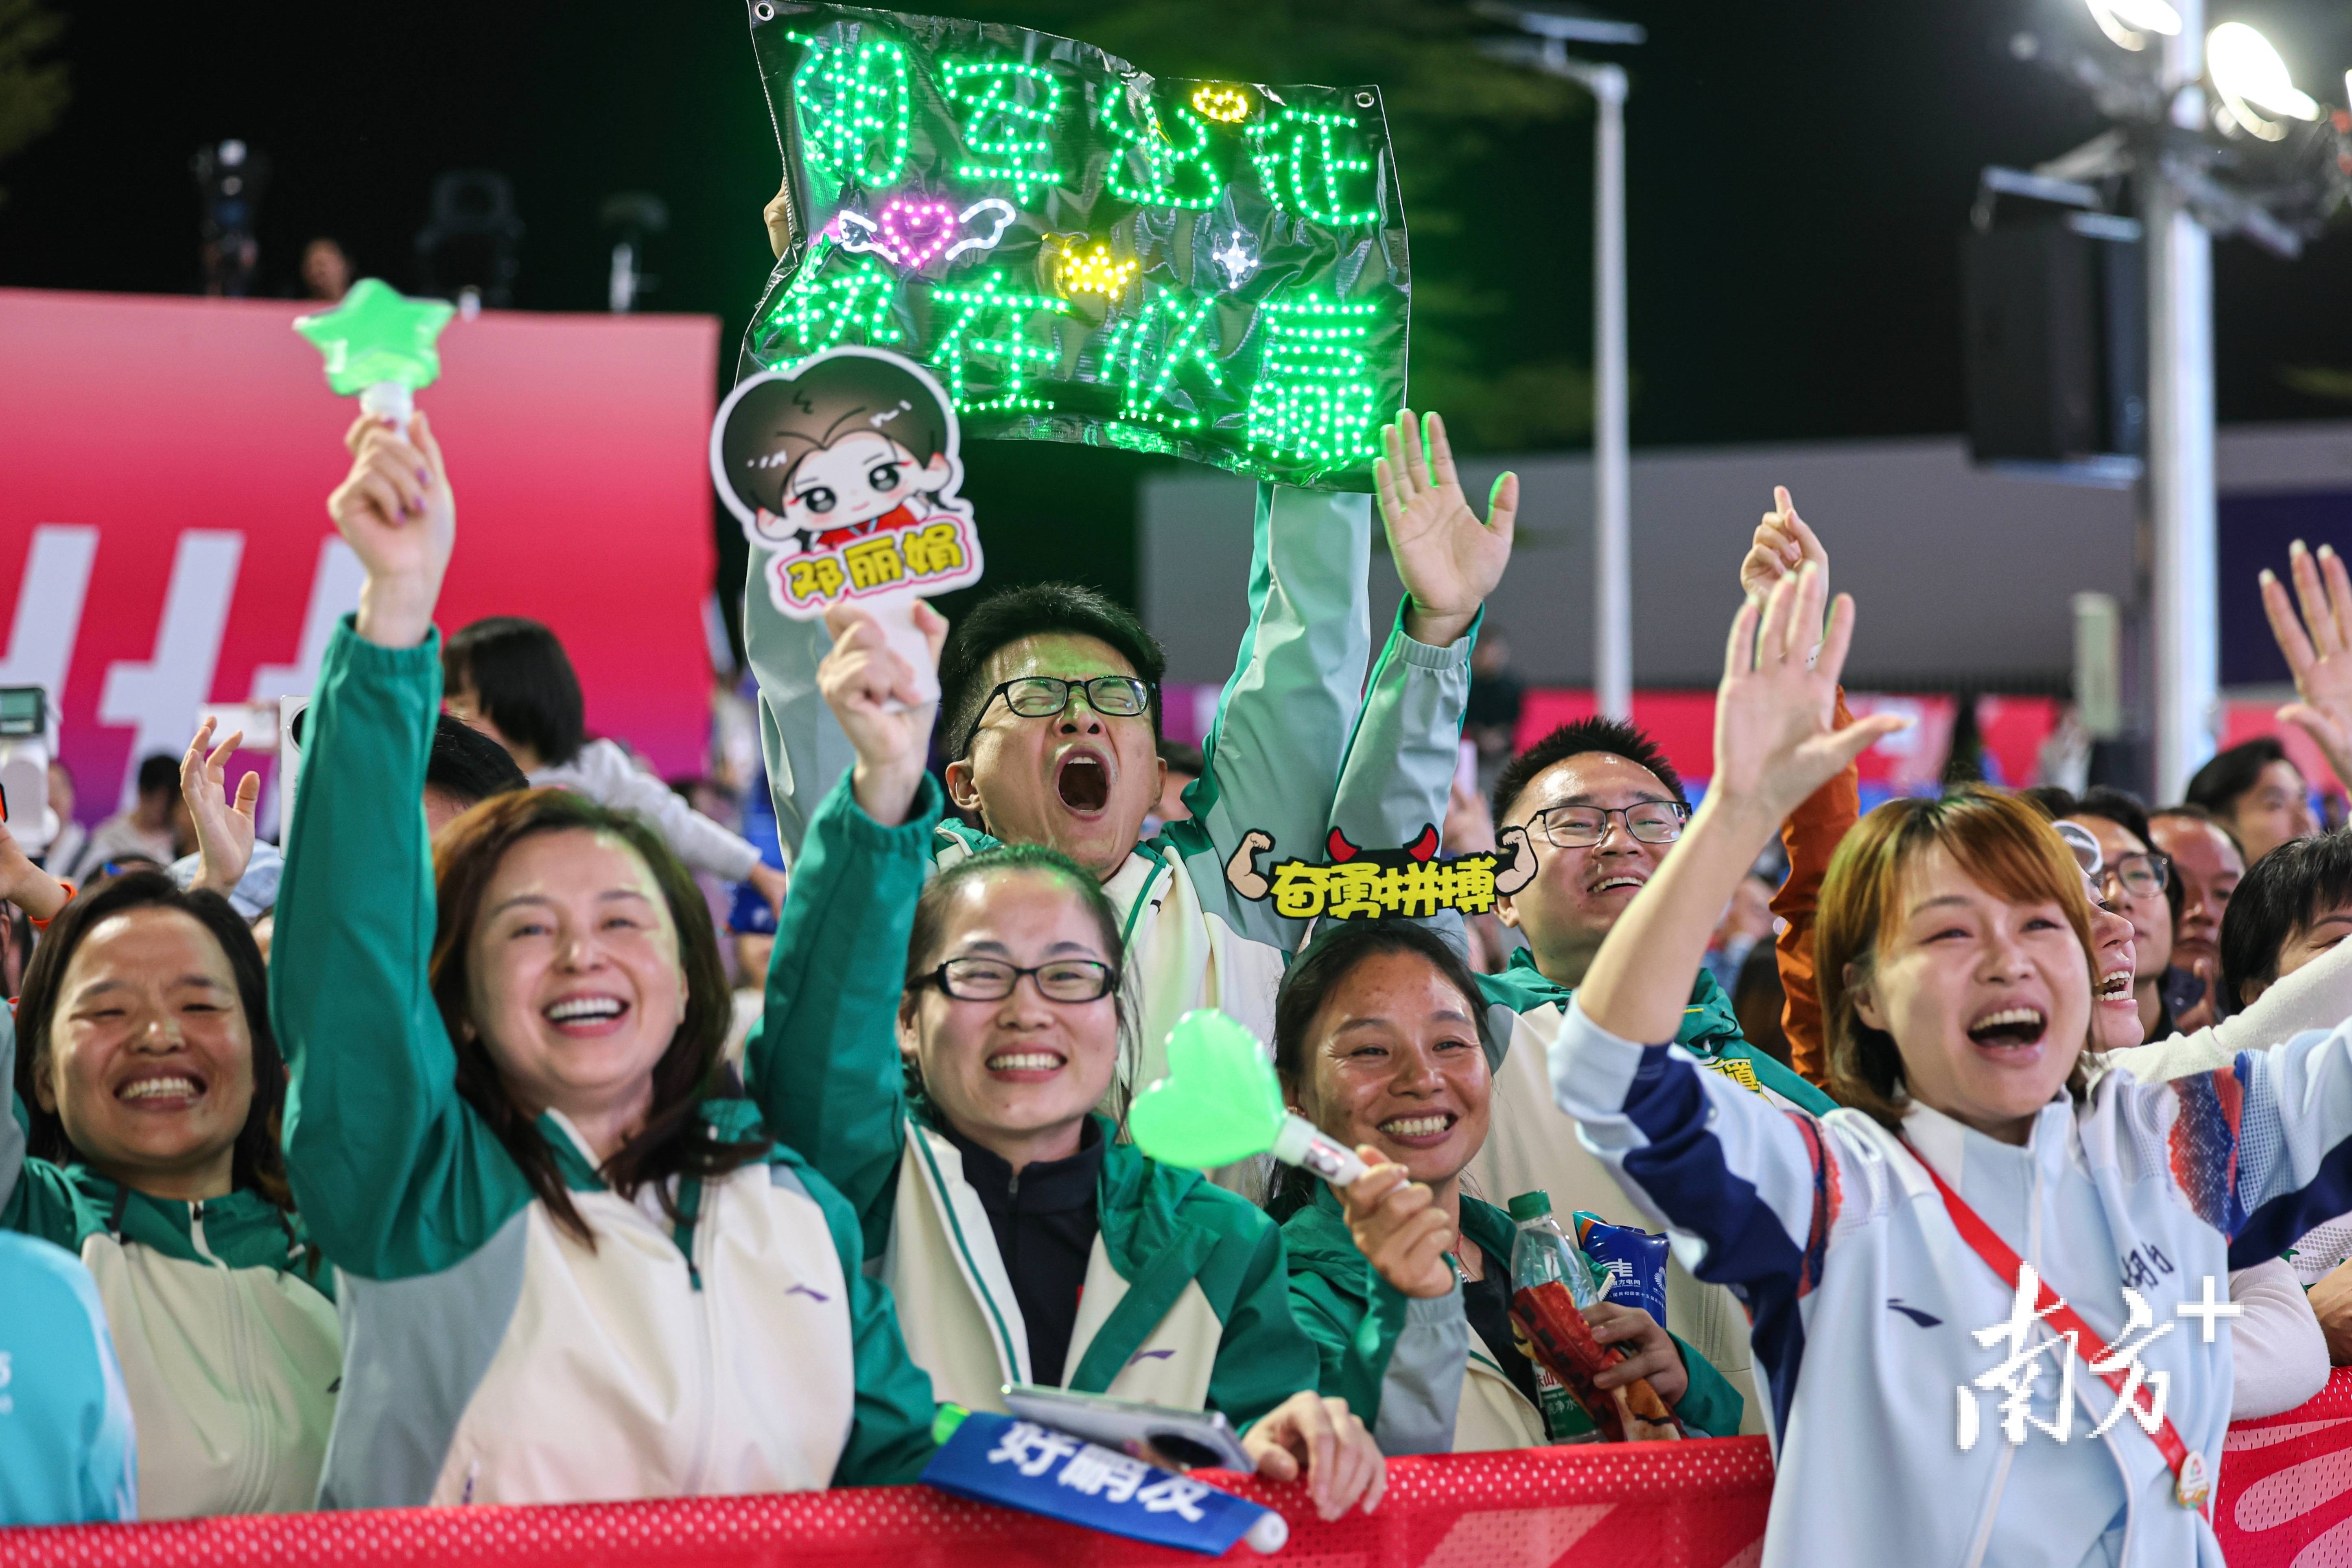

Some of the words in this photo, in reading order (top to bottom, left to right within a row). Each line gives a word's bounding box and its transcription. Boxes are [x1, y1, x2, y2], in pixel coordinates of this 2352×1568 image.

[786, 33, 1380, 226] 湘军出征
[787, 523, 963, 600] 邓丽娟
[1270, 856, 1497, 920] 奋勇拼搏
